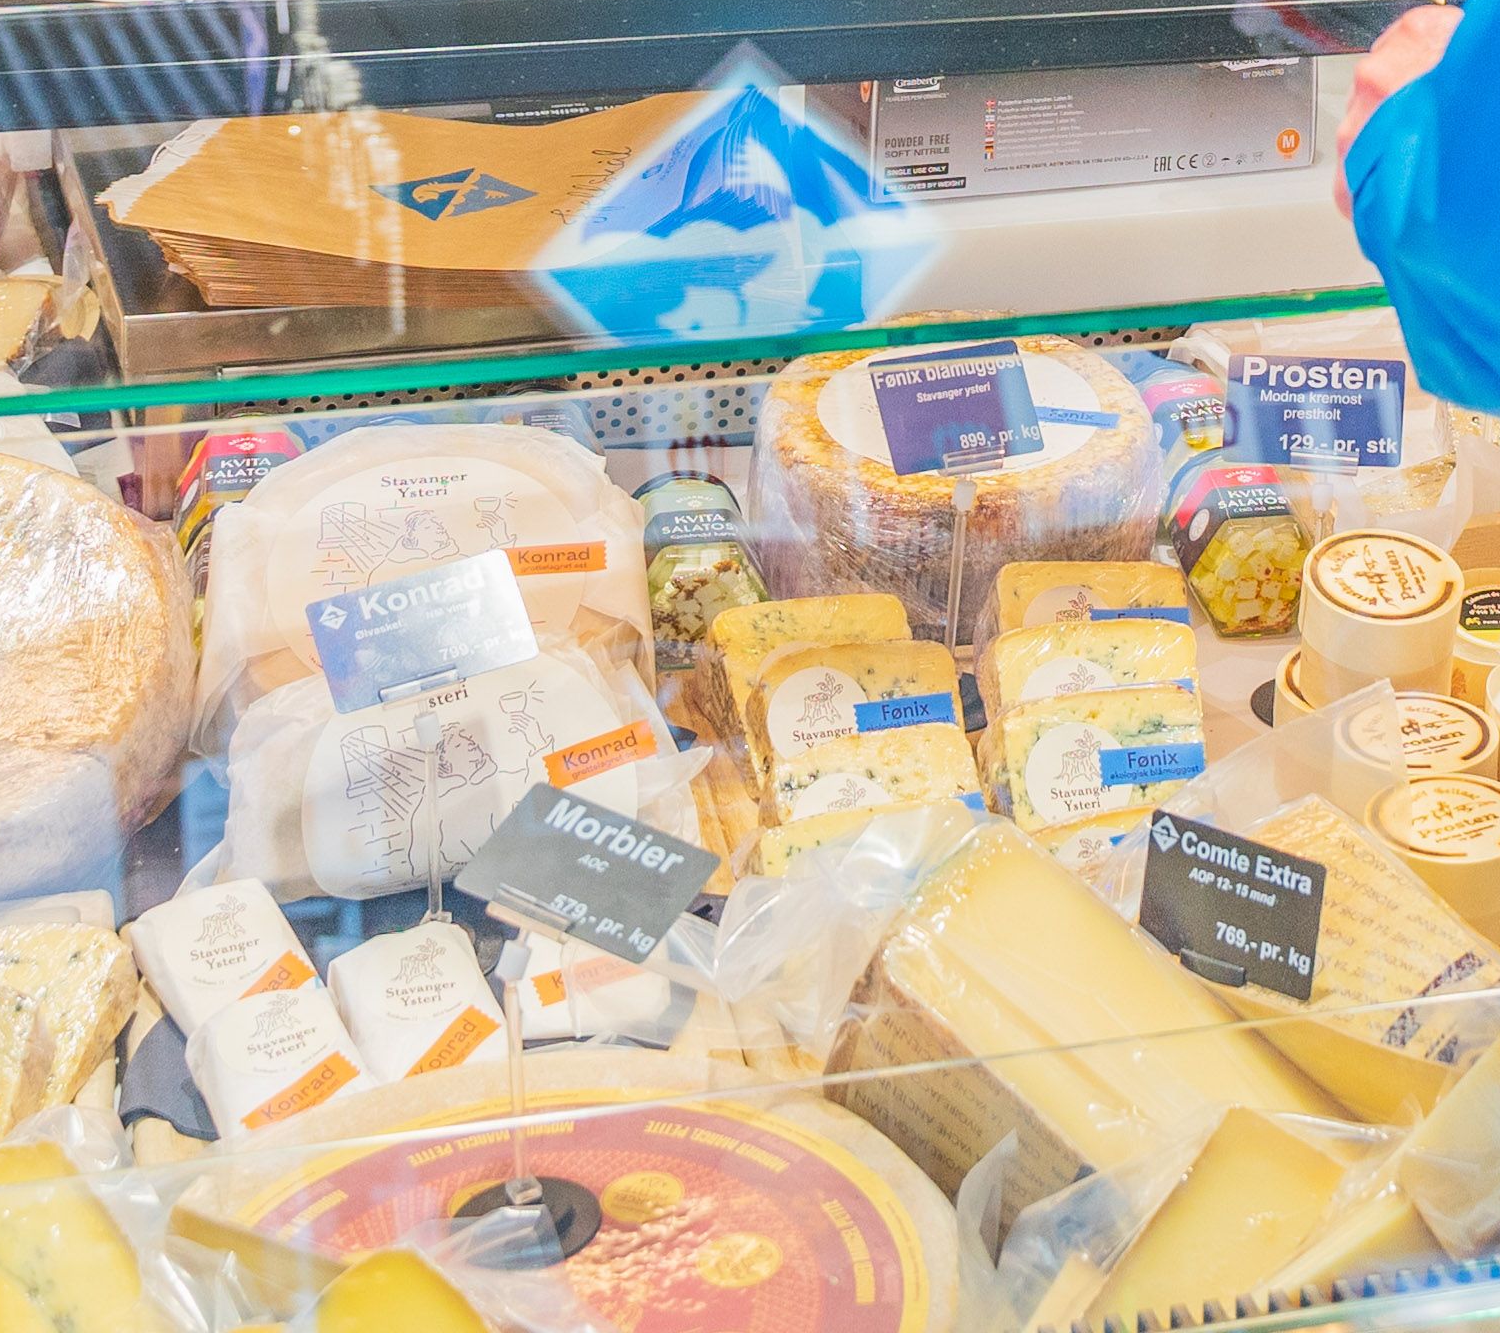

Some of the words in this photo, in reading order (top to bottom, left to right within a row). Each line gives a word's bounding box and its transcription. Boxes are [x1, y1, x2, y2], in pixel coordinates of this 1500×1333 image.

[884, 136, 924, 149] POWDER
[929, 134, 950, 146] FREE
[1281, 135, 1296, 149] M
[884, 149, 910, 159] SOFT
[913, 146, 950, 157] NITRILE
[872, 367, 924, 392] Fønix
[1242, 355, 1388, 392] Prosten
[916, 387, 965, 404] Stavanger
[1177, 397, 1223, 411] KVITA
[1259, 388, 1306, 405] Modna
[1308, 390, 1363, 406] kremost
[1282, 406, 1342, 423] prestholt
[959, 429, 997, 450] 899,-
[998, 428, 1023, 445] pr.
[1332, 438, 1360, 456] pr.
[1365, 435, 1398, 455] stk
[220, 457, 272, 469] KVITA
[205, 467, 270, 481] SALATO
[380, 470, 469, 490] Stavanger
[397, 485, 450, 500] Ysteri
[1227, 487, 1277, 499] KVITA
[674, 513, 726, 524] KVITA
[516, 545, 592, 565] Konrad
[357, 563, 487, 622] Konrad
[427, 688, 470, 709] steri
[881, 700, 930, 722] Fønix
[792, 725, 854, 743] Stavanger
[561, 729, 639, 772] Konrad
[1126, 749, 1180, 769] Fønix
[1109, 767, 1149, 781] økologisk
[1149, 762, 1201, 779] blåmuggost
[1049, 783, 1113, 801] Stavanger
[1064, 799, 1101, 813] Ysteri
[544, 797, 686, 875] Morbier
[1418, 812, 1500, 840] Prosten
[577, 853, 611, 874] AOC
[1180, 830, 1250, 874] Comte
[1254, 854, 1313, 896] Extra
[1188, 867, 1216, 884] AOP
[1235, 882, 1250, 898] 15
[1249, 888, 1277, 908] mnd
[595, 916, 625, 939] pr.
[627, 926, 657, 955] kg
[189, 936, 262, 964] Stavanger
[1215, 920, 1258, 953] 769,-
[1259, 941, 1284, 962] pr.
[1287, 946, 1312, 976] kg
[203, 950, 248, 971] Ysteri
[385, 978, 457, 1002] Stavanger
[399, 991, 443, 1009] Ysteri
[245, 1023, 319, 1059] Stavanger
[263, 1038, 308, 1062] Ysteri
[260, 1061, 336, 1123] Konrad
